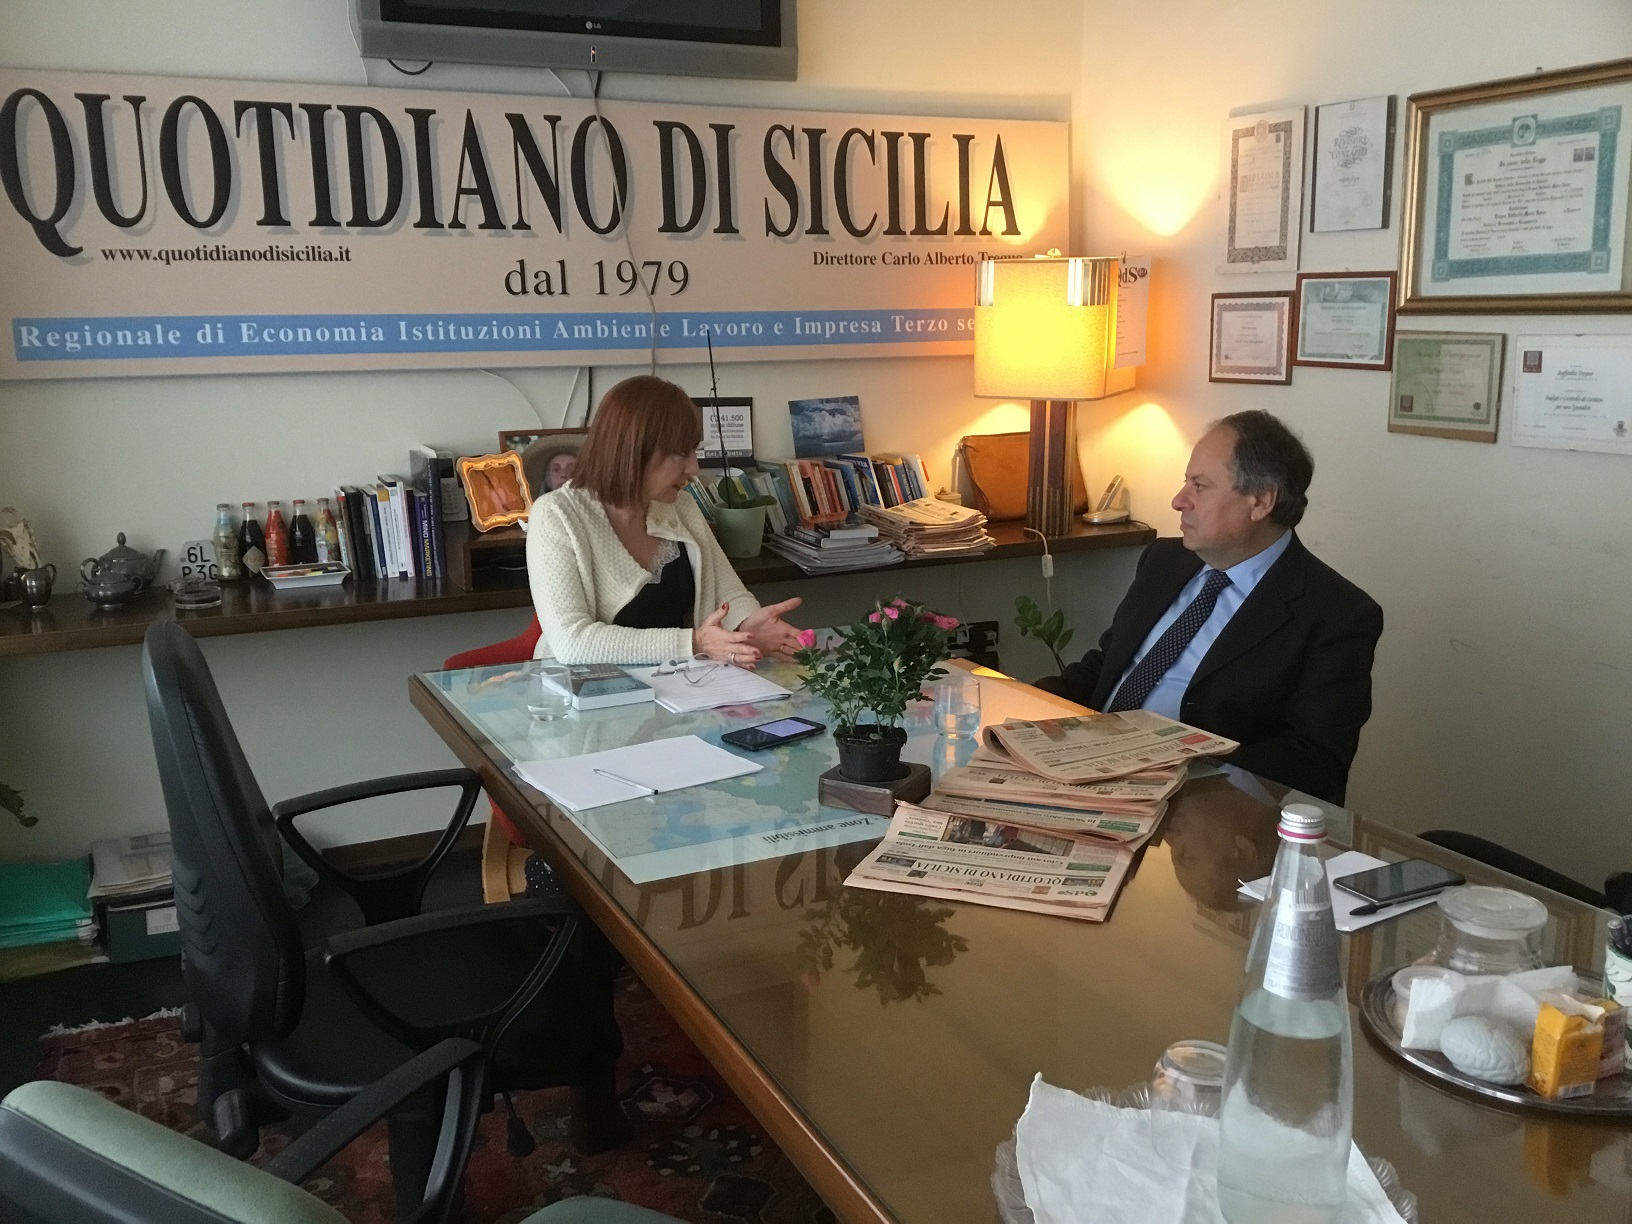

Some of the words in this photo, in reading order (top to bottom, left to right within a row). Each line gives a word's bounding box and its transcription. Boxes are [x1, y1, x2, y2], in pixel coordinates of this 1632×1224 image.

[0, 88, 627, 257] QUOTIDIANO
[653, 120, 740, 234] DI
[763, 123, 1022, 238] SICILIA
[101, 246, 352, 266] www.quotidianodisicilia.it
[813, 251, 877, 266] Direttore
[881, 251, 920, 266] Carlo
[924, 251, 974, 266] Alberto
[504, 260, 571, 296] dal
[593, 260, 690, 296] 1979
[20, 322, 182, 351] Regionale
[196, 323, 226, 345] di
[240, 321, 385, 344] Economia
[398, 319, 542, 342] Istituzioni
[553, 319, 671, 339] Ambiente
[681, 318, 764, 338] Lavoro
[773, 321, 784, 336] e
[794, 317, 882, 338] Impresa
[891, 315, 949, 333] Terzo
[187, 545, 211, 564] 6L
[837, 817, 875, 828] Zone
[762, 824, 834, 844] ammissibili
[917, 861, 960, 874] SICILIA
[963, 868, 977, 877] DI
[980, 870, 1062, 885] QUOTIDIANO
